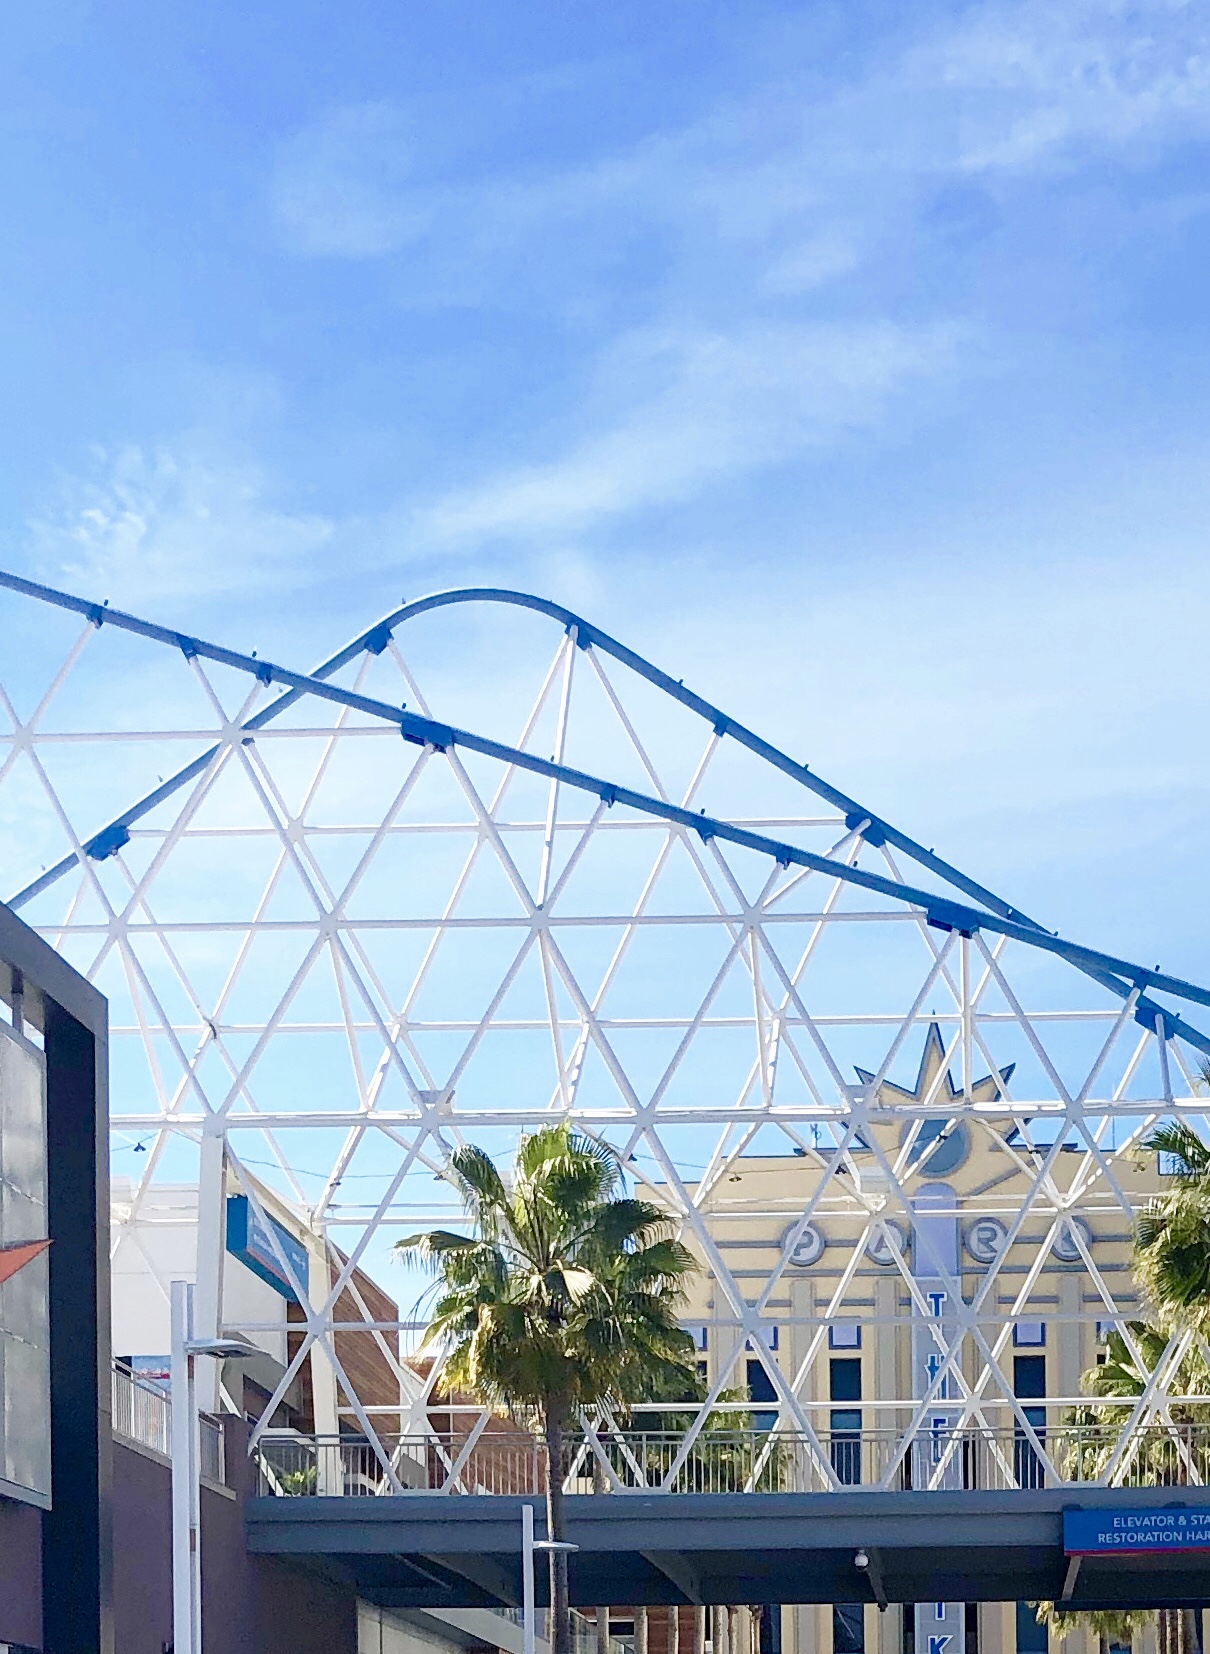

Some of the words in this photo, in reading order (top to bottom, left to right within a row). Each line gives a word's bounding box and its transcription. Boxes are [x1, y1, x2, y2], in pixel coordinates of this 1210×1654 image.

[1113, 1516, 1175, 1528] ELEVATOR
[1178, 1515, 1187, 1526] &
[1097, 1531, 1184, 1544] RESTORATION
